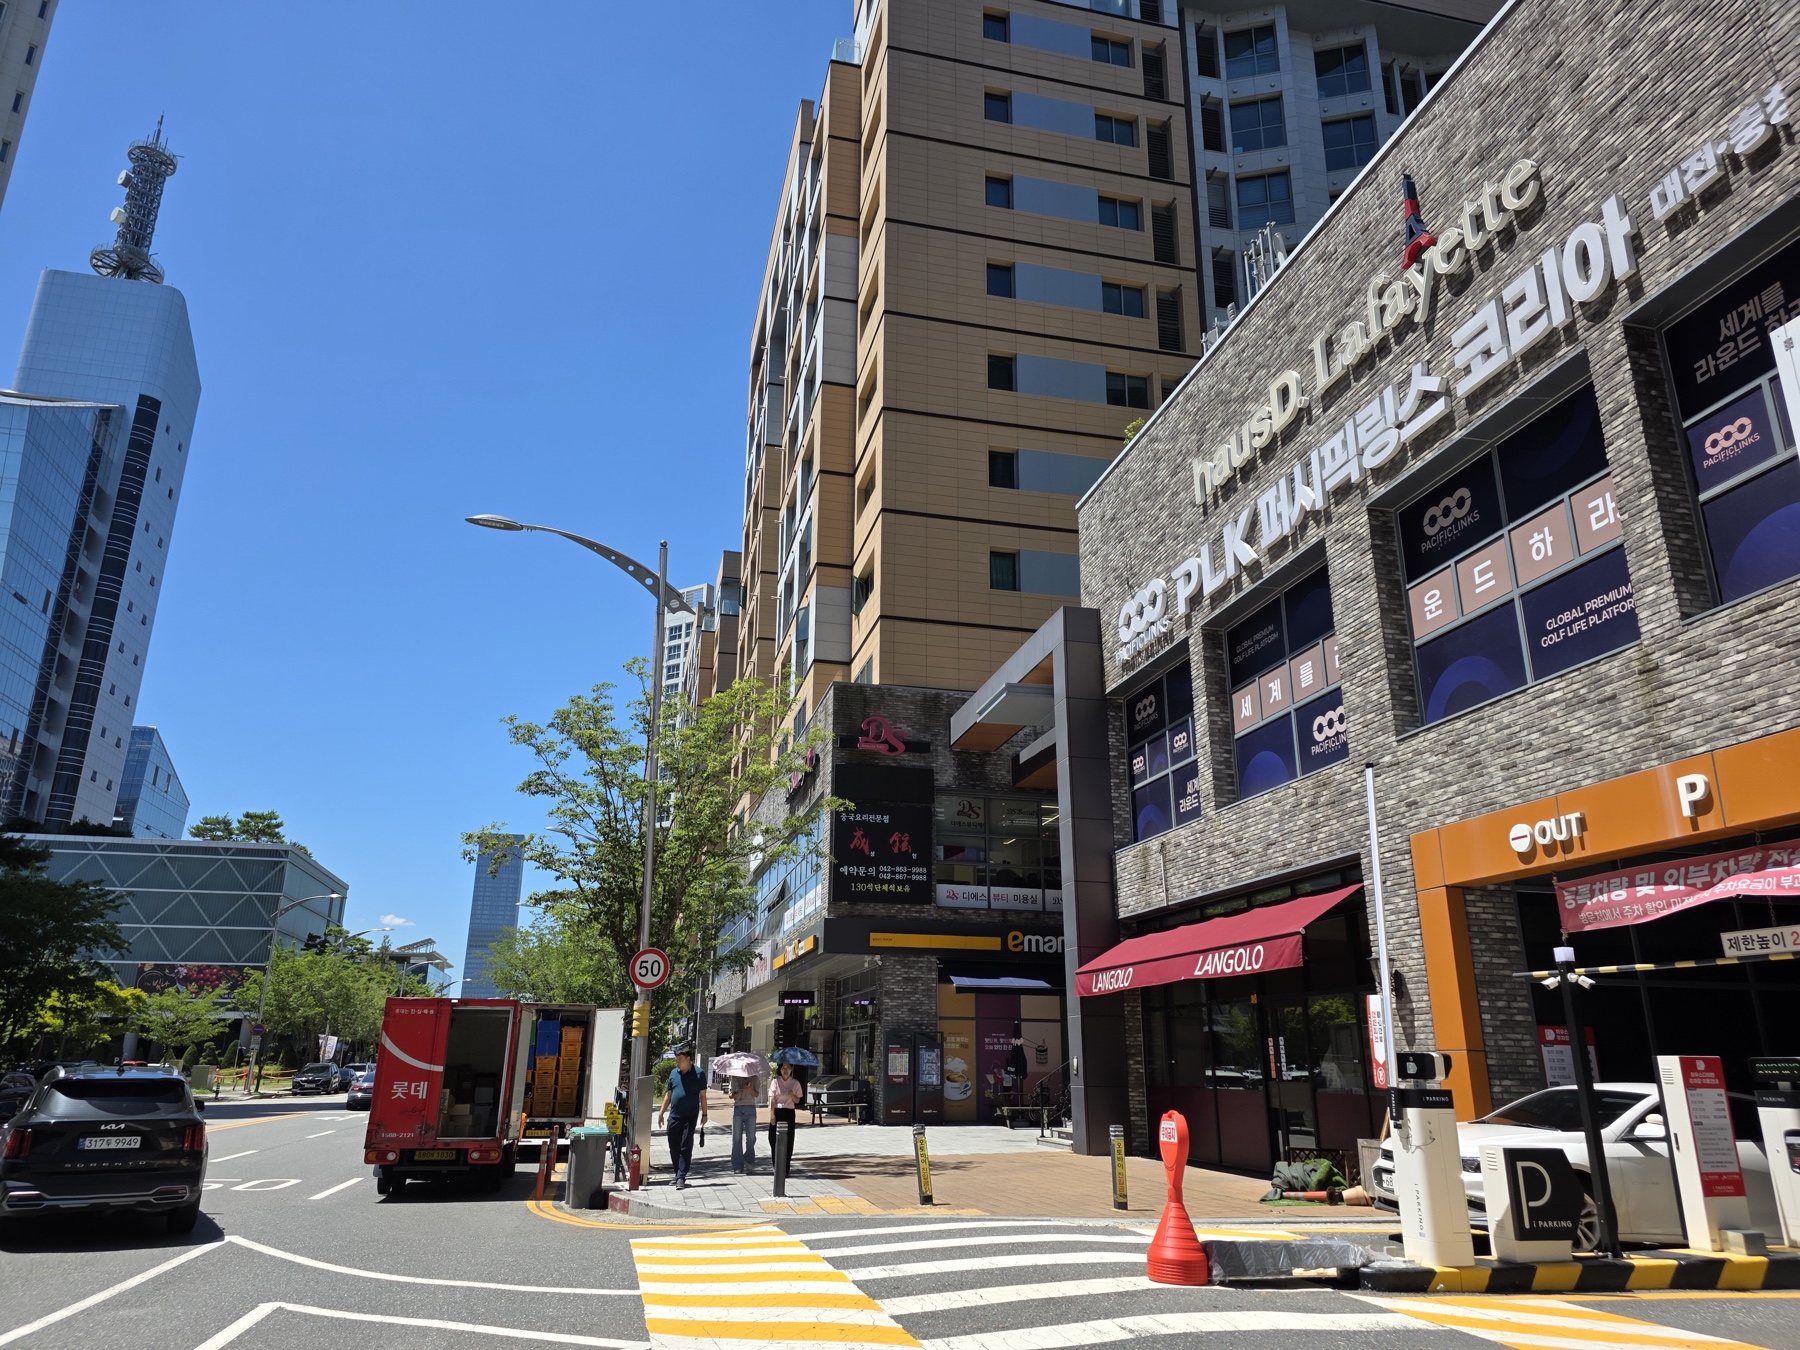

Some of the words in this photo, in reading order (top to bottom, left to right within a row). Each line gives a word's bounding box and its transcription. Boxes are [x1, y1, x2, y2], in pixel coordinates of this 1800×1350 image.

[1309, 159, 1541, 396] Lafayette
[1719, 281, 1785, 342] 세계를
[1694, 326, 1761, 384] 라운드
[1171, 504, 1259, 616] PLK
[1257, 361, 1451, 548] 퍼시픽링스
[1451, 194, 1638, 397] 코리아
[1702, 432, 1761, 469] PACIFICLINKS
[1421, 511, 1480, 554] PACIFICLINKS
[1541, 627, 1566, 648] GOLF
[1566, 618, 1588, 638] LIFE
[1588, 597, 1636, 628] PLATFOR
[1546, 607, 1584, 631] GLOBAL
[1585, 582, 1633, 613] PREMIUM
[1676, 773, 1710, 818] P
[840, 812, 890, 824] 중국요리전문점
[1534, 811, 1585, 845] OUT
[839, 865, 876, 877] 예약문의
[879, 865, 927, 874] 042-863-9988
[879, 873, 927, 881] 042-867-9988
[1562, 876, 1629, 910] 등록차량
[1635, 870, 1655, 897] 및
[1663, 852, 1763, 892] 외부차량
[962, 891, 987, 902] 디에스
[992, 893, 1009, 904] 뷰티
[1013, 893, 1038, 905] 미용실
[1623, 903, 1644, 919] 주차
[1645, 899, 1668, 915] 할인
[1713, 876, 1777, 894] 주차요금이
[1727, 931, 1787, 952] 제한높이
[638, 959, 661, 978] 50
[1194, 944, 1264, 976] LANGOLO
[1091, 967, 1133, 993] LANGOLO
[390, 1081, 429, 1100] 롯데
[115, 1137, 139, 1147] 9949
[919, 1139, 927, 1165] 오토바이
[1116, 1142, 1124, 1170] 오토바이
[64, 1160, 147, 1168] SORENTO
[1414, 1189, 1424, 1231] PARKING
[1538, 1220, 1573, 1228] PARKING
